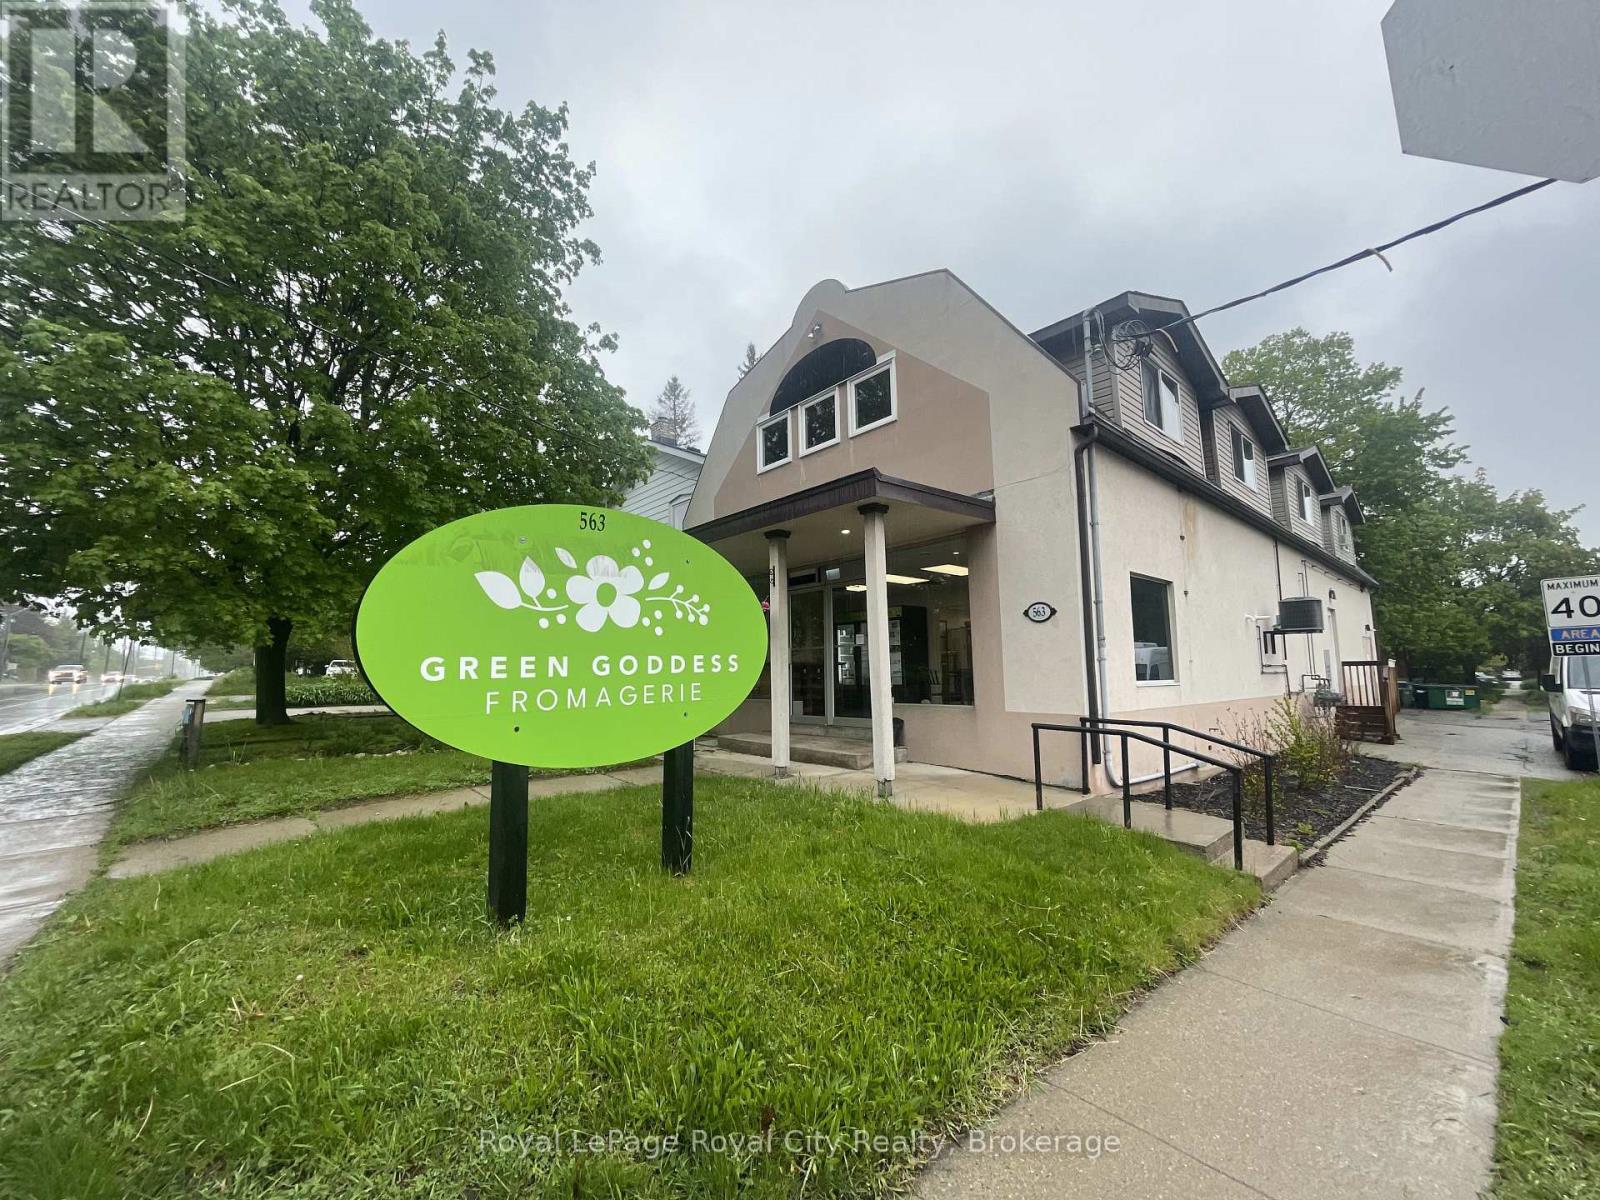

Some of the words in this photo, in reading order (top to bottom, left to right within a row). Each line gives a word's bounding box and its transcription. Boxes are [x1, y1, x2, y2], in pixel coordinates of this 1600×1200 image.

[580, 511, 605, 531] 563
[1547, 580, 1599, 590] MAXIMUM
[1032, 606, 1046, 617] 563
[1551, 595, 1600, 618] 40
[1561, 628, 1600, 640] AREA
[420, 656, 569, 682] GREEN
[592, 654, 739, 676] GODDESS
[486, 683, 702, 715] FROMAGERIE
